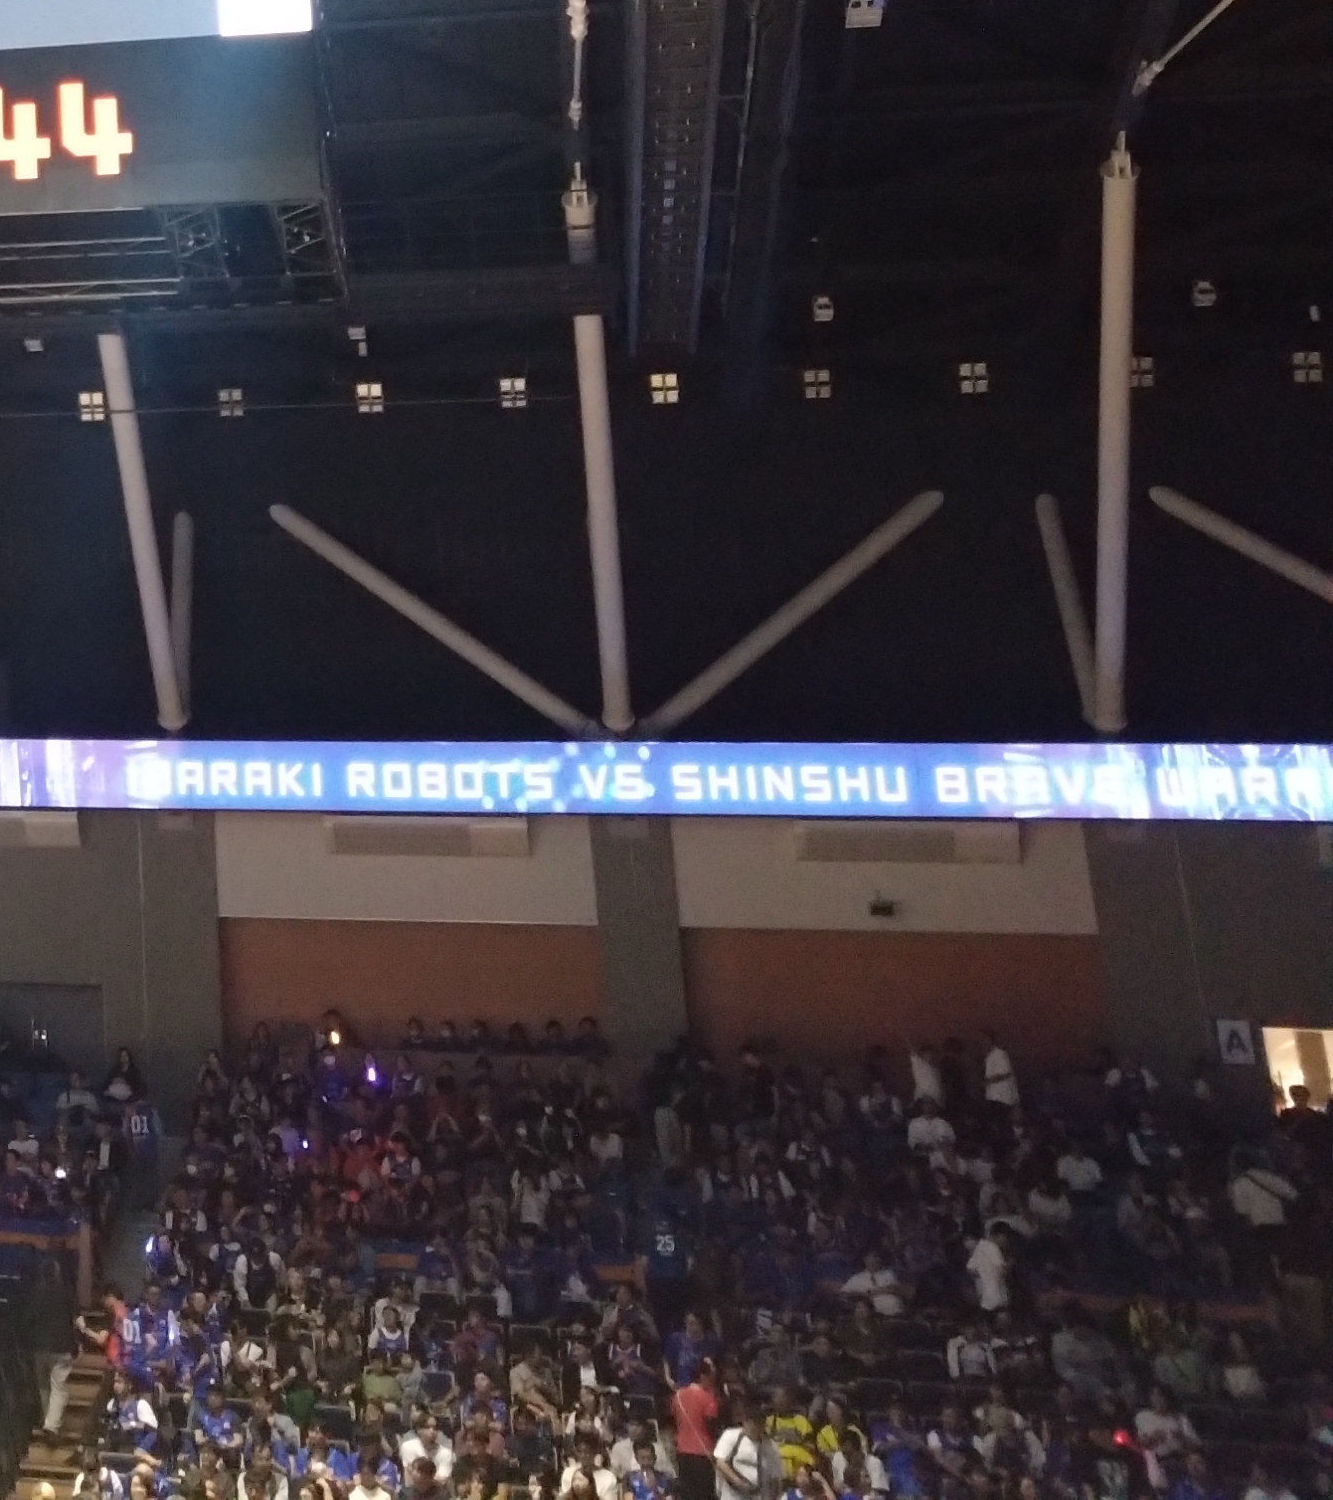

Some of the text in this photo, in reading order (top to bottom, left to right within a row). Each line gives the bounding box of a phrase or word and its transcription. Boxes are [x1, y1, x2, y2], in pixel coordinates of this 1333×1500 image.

[127, 757, 321, 798] BARAKI
[346, 761, 553, 799] ROBOTS
[579, 763, 646, 801] VS
[672, 764, 908, 803] SHINSHU
[1226, 1029, 1248, 1053] A
